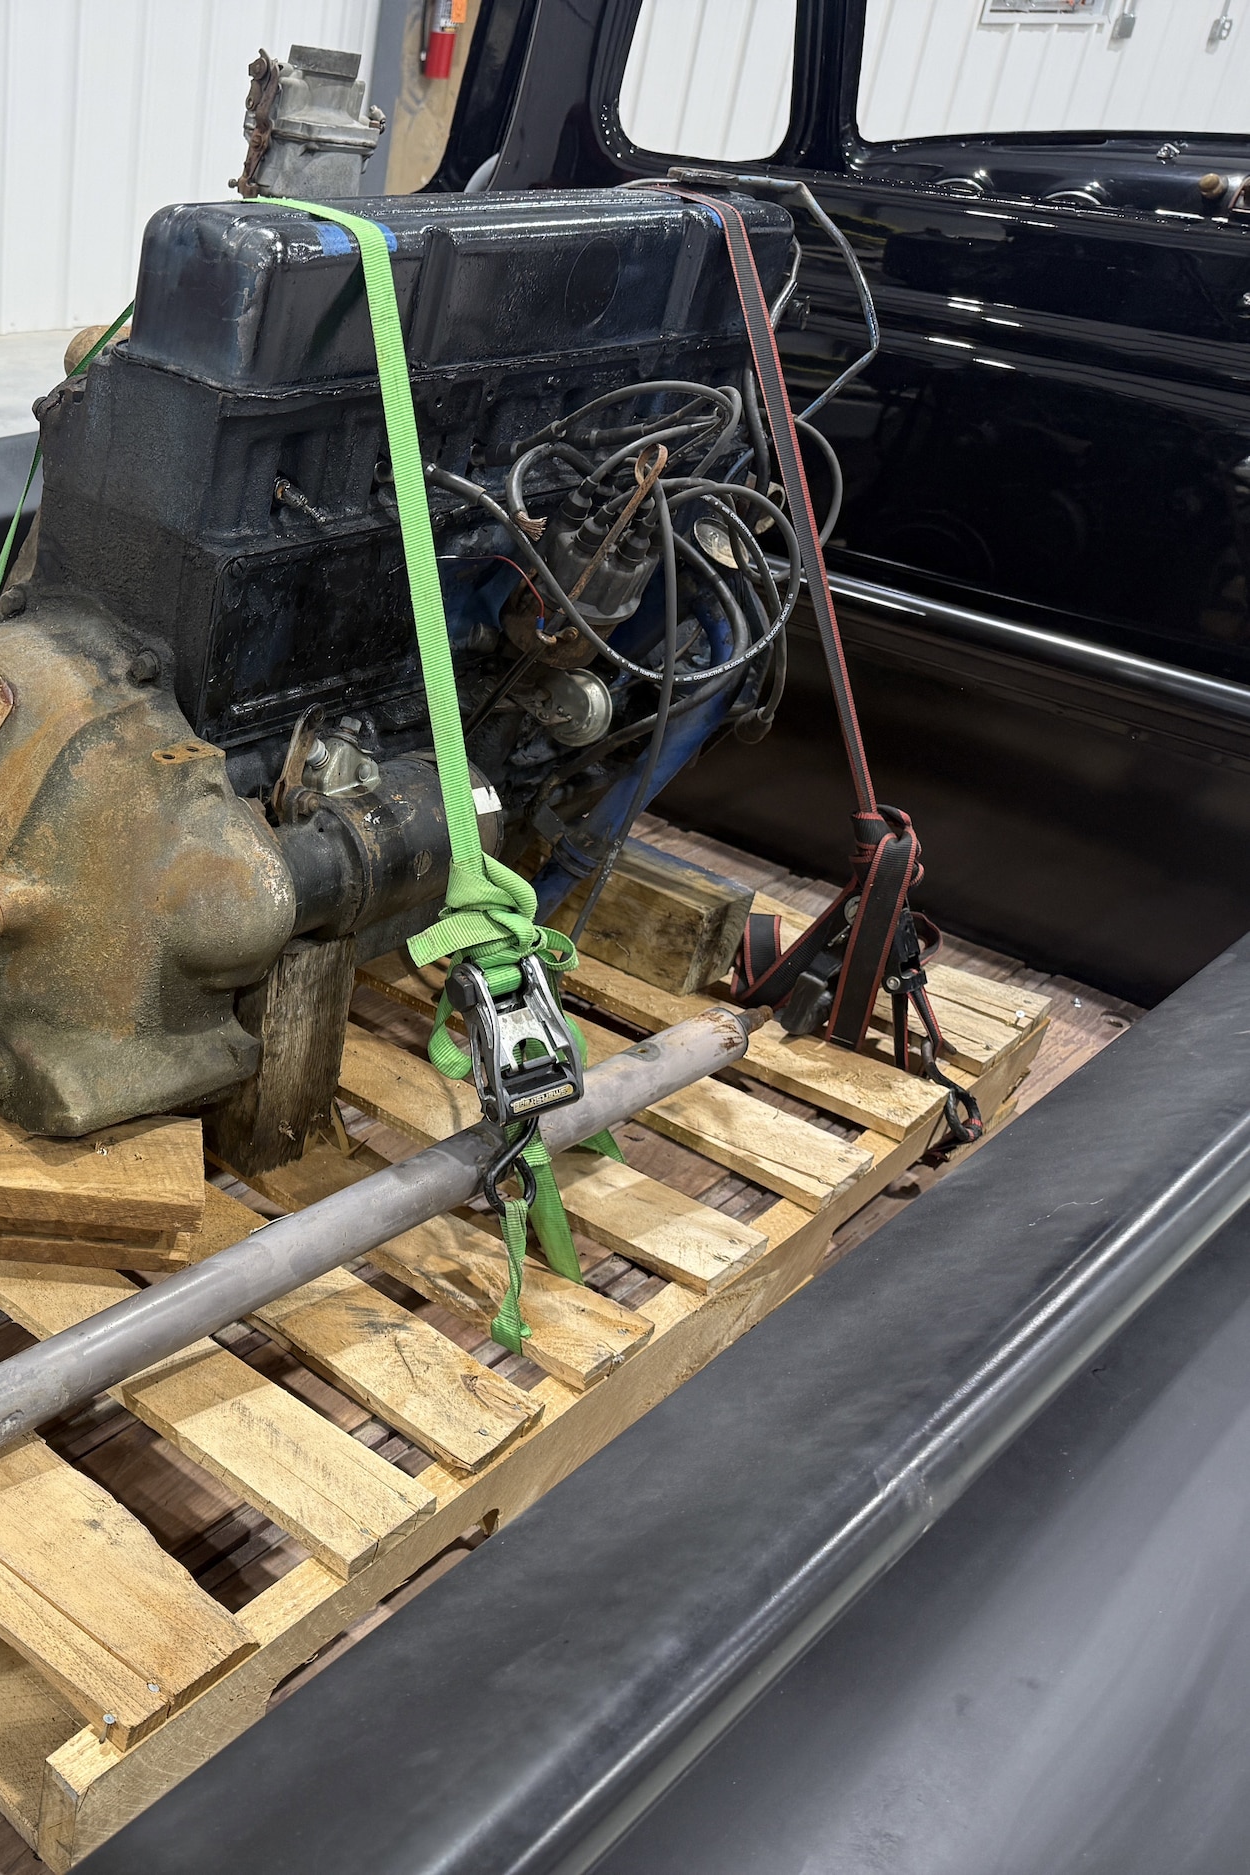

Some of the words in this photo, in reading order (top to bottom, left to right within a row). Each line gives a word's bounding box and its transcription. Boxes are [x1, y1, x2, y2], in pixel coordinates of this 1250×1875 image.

[693, 667, 724, 681] CONDUCTIVE
[724, 656, 746, 671] SILICONE
[745, 647, 759, 659] CORE
[765, 621, 782, 642] SILICONE
[780, 603, 791, 622] JACKET
